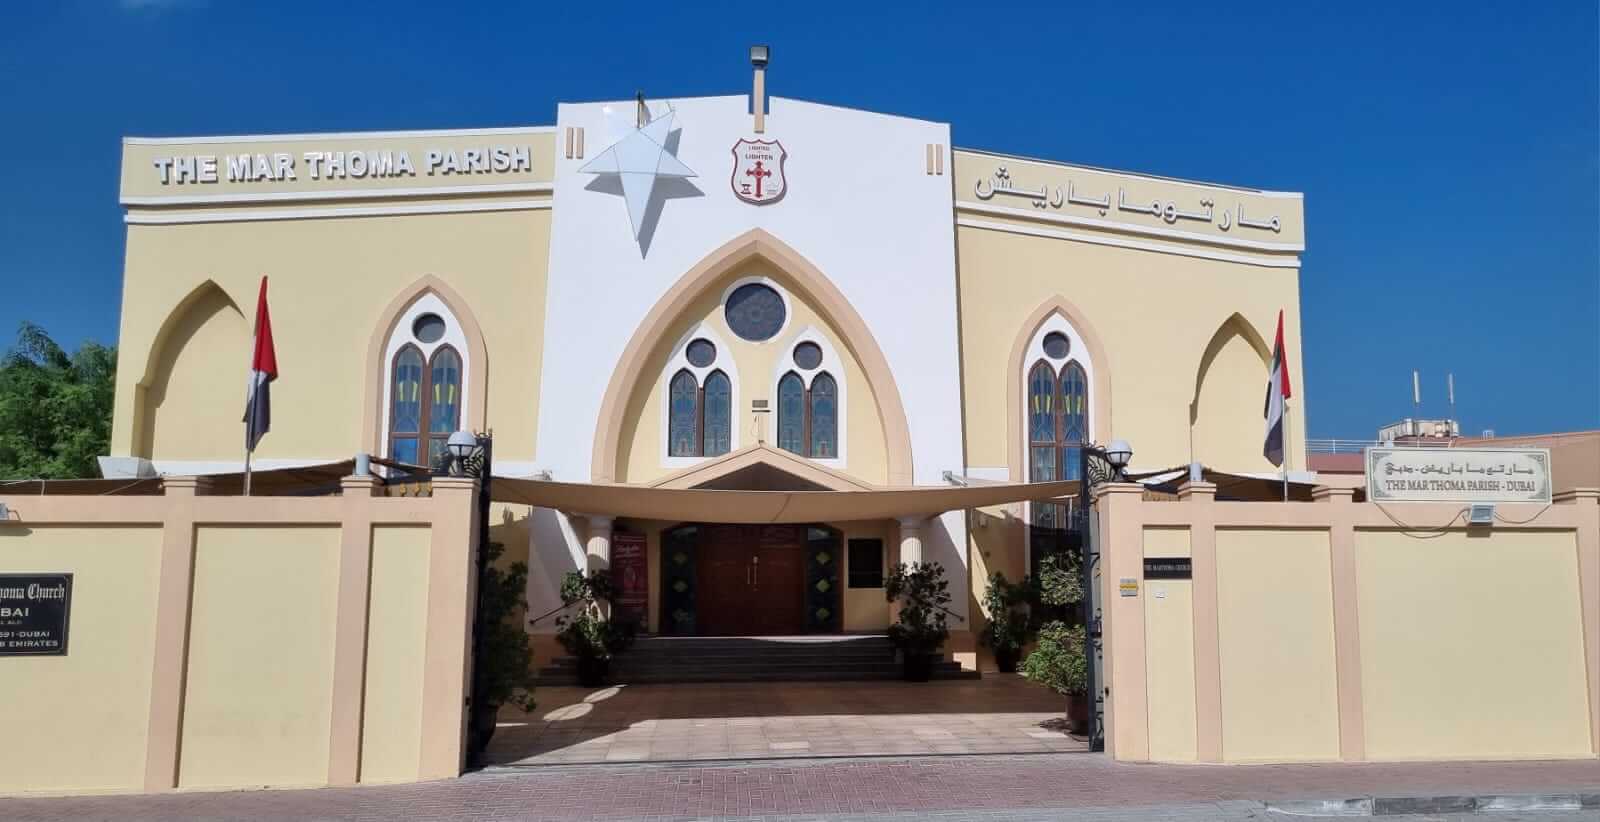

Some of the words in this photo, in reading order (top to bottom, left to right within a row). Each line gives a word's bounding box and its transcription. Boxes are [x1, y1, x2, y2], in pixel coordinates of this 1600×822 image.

[153, 156, 219, 185] THE
[226, 152, 297, 182] MAR
[304, 150, 416, 178] THOMA
[426, 144, 533, 176] PARISH
[745, 153, 774, 161] LIGHTEN
[975, 166, 1111, 217] باريش
[1385, 480, 1407, 491] THE
[1407, 480, 1429, 491] MAR
[1429, 480, 1467, 491] THOMA
[1467, 480, 1500, 491] PARISH
[1506, 480, 1536, 492] DUBAI
[27, 583, 65, 604] Church
[9, 640, 59, 648] EMIRATES
